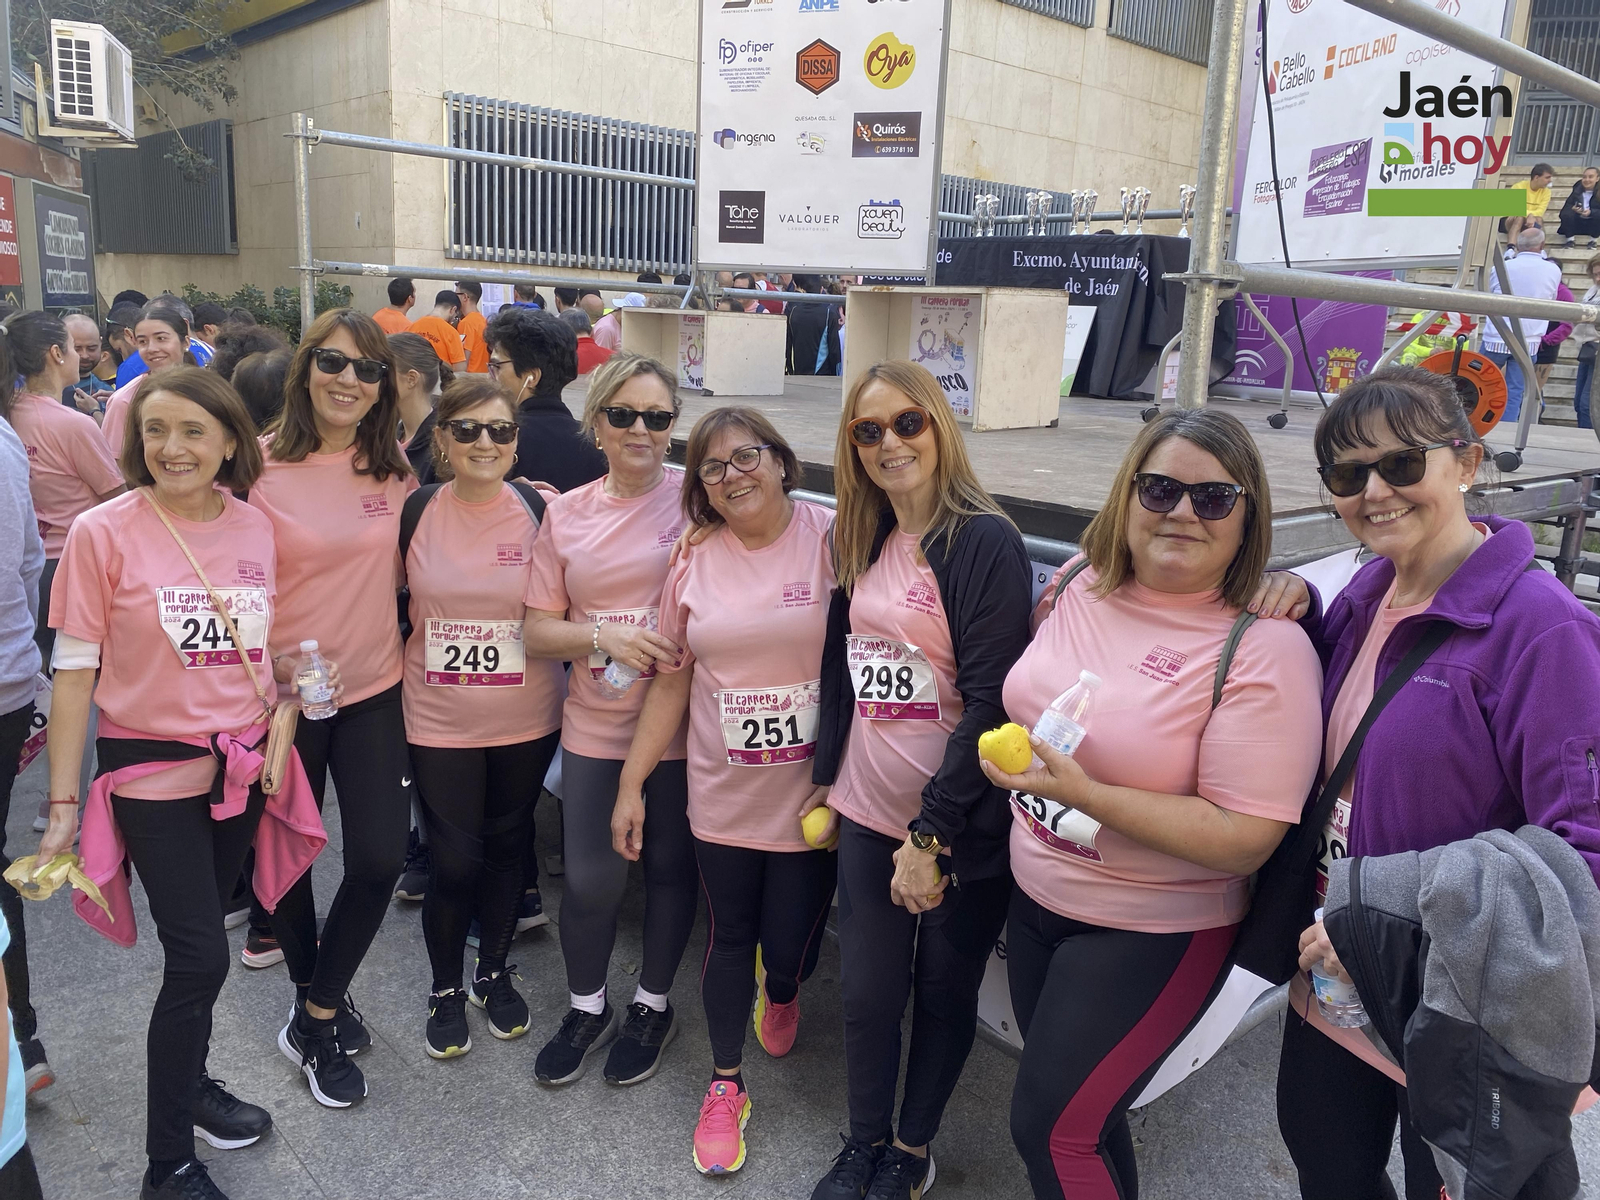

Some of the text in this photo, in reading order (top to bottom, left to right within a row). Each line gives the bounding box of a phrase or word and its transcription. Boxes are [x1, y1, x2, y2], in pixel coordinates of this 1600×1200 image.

[740, 40, 774, 56] ofiper
[1338, 33, 1398, 69] COCILAND
[802, 59, 834, 76] DISSA
[866, 43, 914, 83] Oya
[1282, 51, 1306, 74] Bello
[1280, 66, 1316, 92] Cabello
[872, 122, 906, 136] Quirós
[736, 133, 776, 146] ingenia
[1399, 160, 1456, 182] morales
[1254, 176, 1298, 194] FERCLOR
[724, 205, 759, 219] Tahe
[778, 214, 840, 224] VALQUER
[936, 248, 952, 264] de
[1012, 250, 1067, 268] Excmo.
[1064, 277, 1120, 296] de Jaén
[926, 609, 942, 618] Bosco
[444, 645, 500, 672] 249
[858, 665, 914, 701] 298
[1139, 668, 1149, 676] San
[1149, 674, 1163, 682] Juan
[742, 715, 803, 749] 251
[1491, 1087, 1500, 1130] TRIBORD
